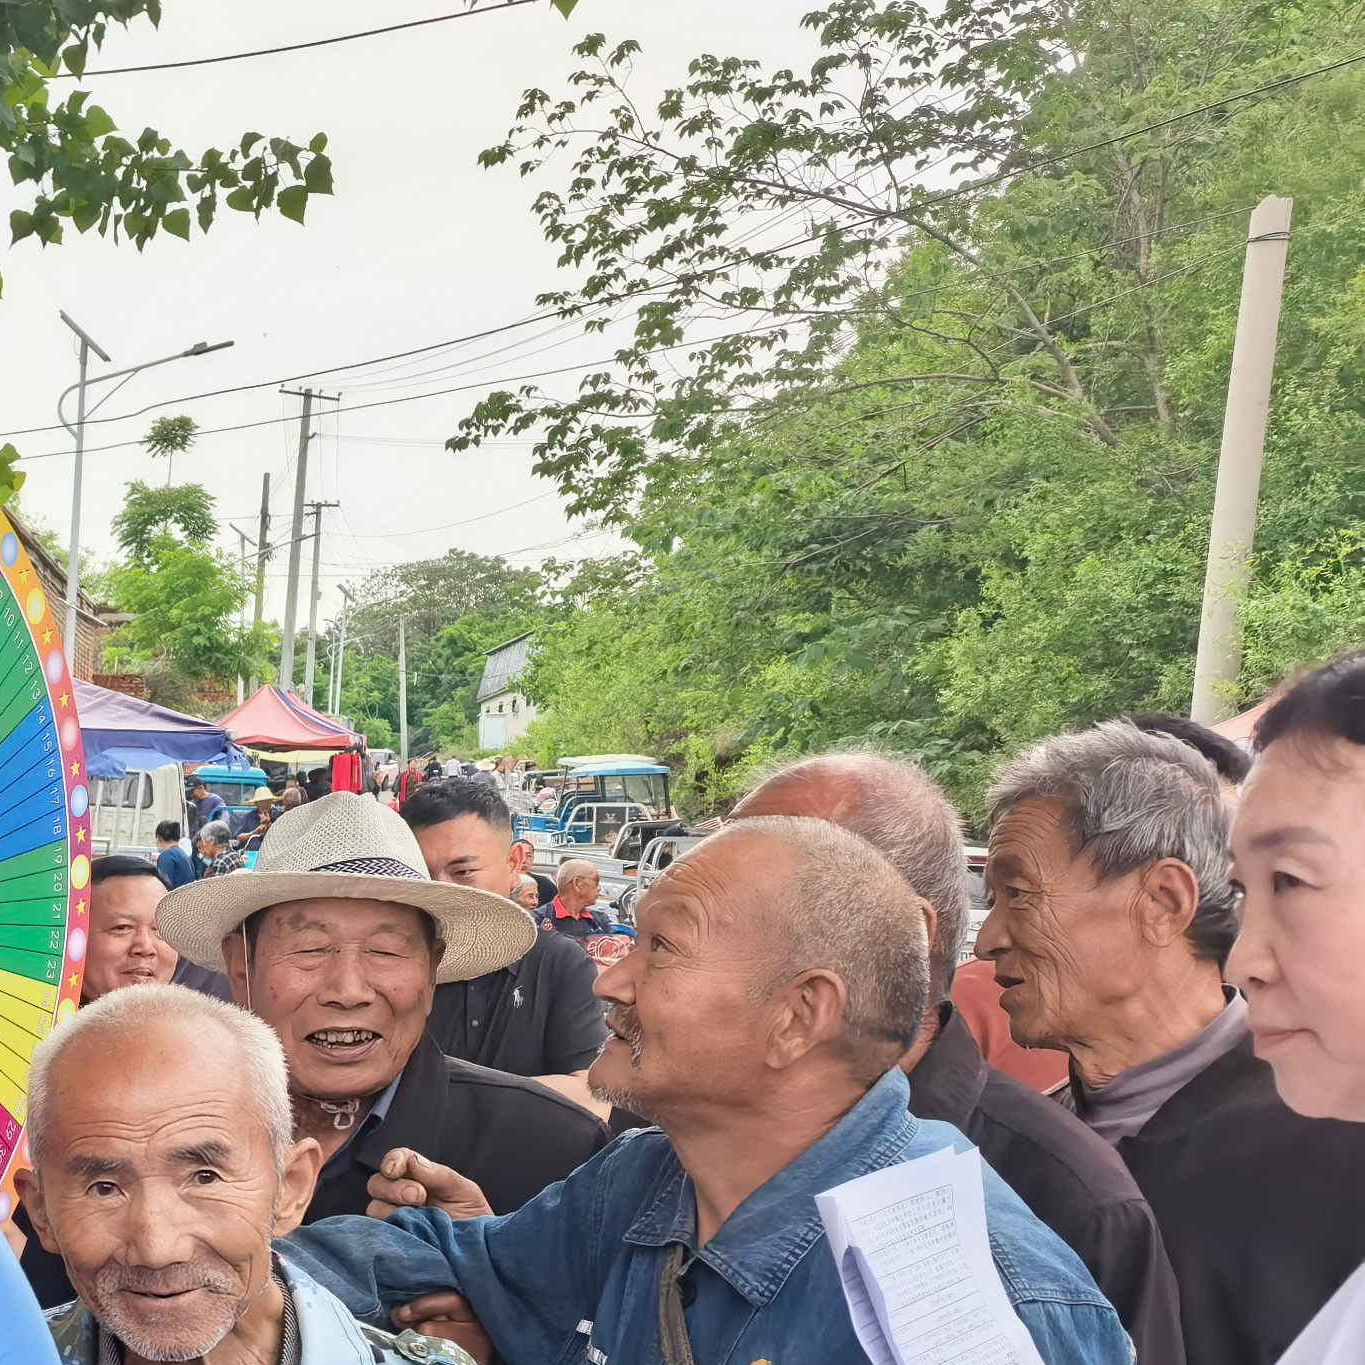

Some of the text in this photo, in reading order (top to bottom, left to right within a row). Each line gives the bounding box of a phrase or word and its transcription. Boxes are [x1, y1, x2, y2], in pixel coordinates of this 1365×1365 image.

[4, 608, 15, 627] 10
[14, 631, 24, 649] 11
[22, 655, 33, 675] 12
[30, 681, 41, 700] 13
[36, 705, 47, 724] 14
[42, 732, 52, 752] 15
[46, 759, 57, 778] 16
[50, 787, 60, 804] 17
[52, 817, 62, 835] 18
[54, 846, 63, 864] 19
[53, 873, 63, 892] 20
[52, 903, 62, 919] 21
[50, 931, 60, 949] 22
[46, 960, 57, 979] 23
[6, 1120, 16, 1140] 29
